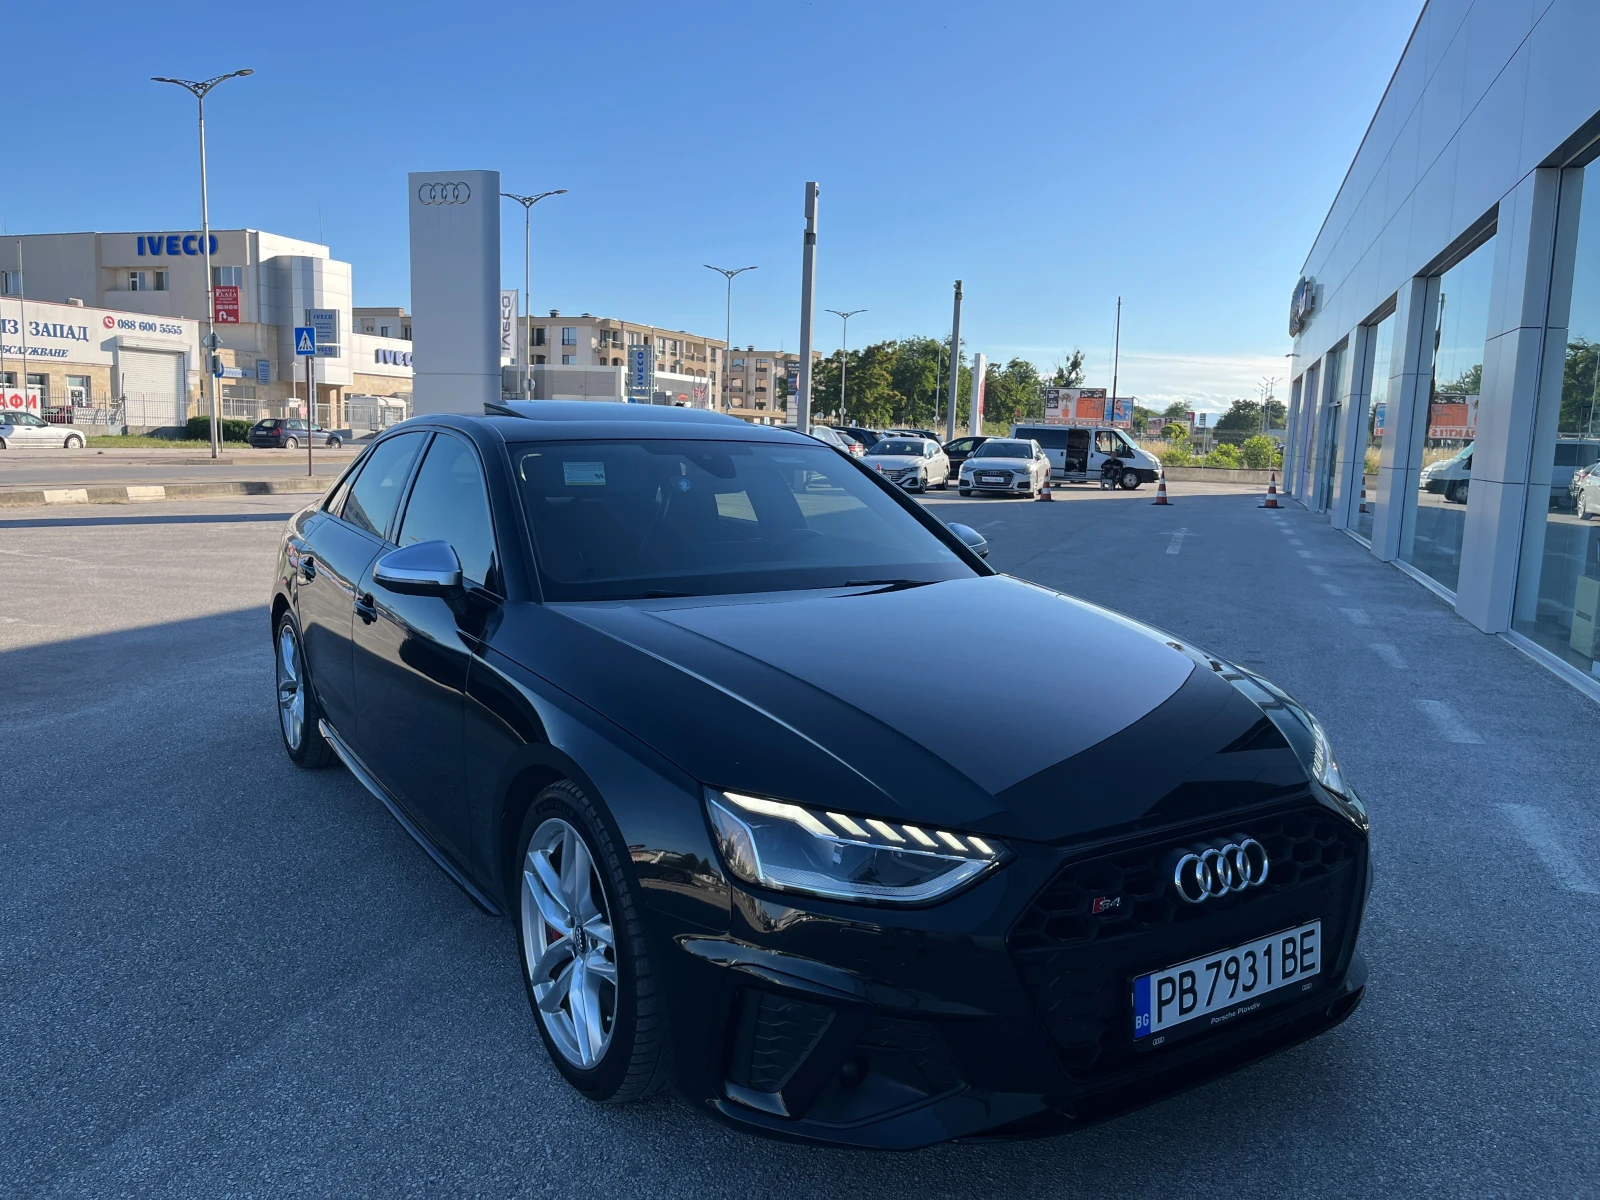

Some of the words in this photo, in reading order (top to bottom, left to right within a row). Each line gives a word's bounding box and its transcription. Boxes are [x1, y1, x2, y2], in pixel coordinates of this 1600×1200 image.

[137, 234, 218, 256] IVECO
[215, 288, 237, 298] PLAZA
[29, 320, 89, 342] ЗАПАД
[117, 318, 137, 330] 088
[138, 321, 157, 332] 600
[159, 323, 182, 335] 5555
[501, 295, 511, 350] IVECO
[0, 344, 69, 358] БСЛУЖВАНЕ
[375, 348, 413, 367] IVEC
[1099, 896, 1122, 910] S4
[1135, 1012, 1150, 1029] BG
[1210, 1010, 1237, 1025] Porsche
[1237, 1001, 1261, 1017] Plovdiv
